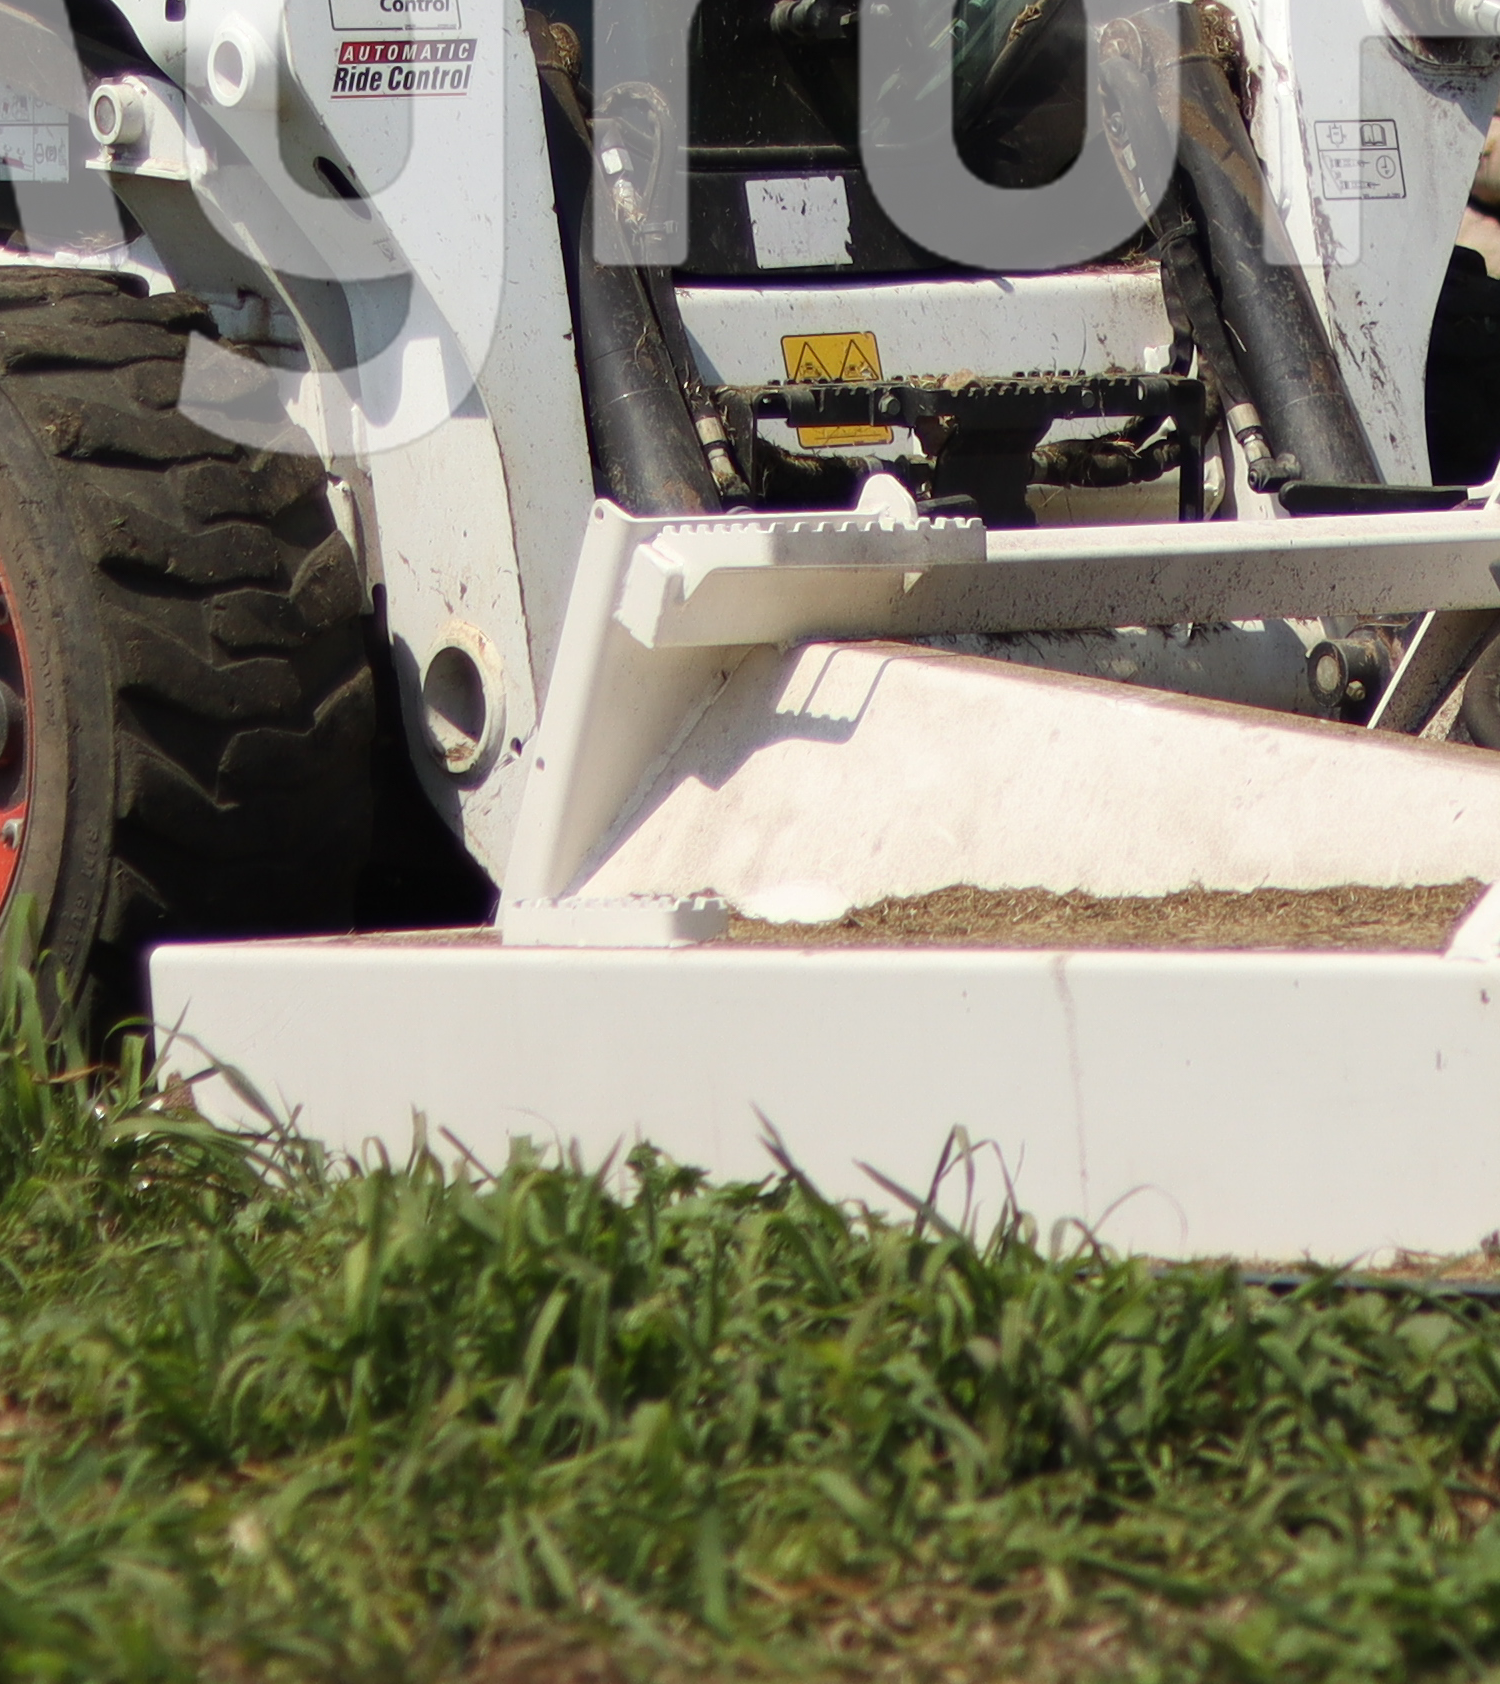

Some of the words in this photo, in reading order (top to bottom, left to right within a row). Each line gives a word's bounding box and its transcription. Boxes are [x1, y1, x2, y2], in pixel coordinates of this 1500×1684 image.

[343, 43, 470, 62] AUTOMATIC
[332, 66, 383, 93] Ride
[388, 64, 472, 92] Control
